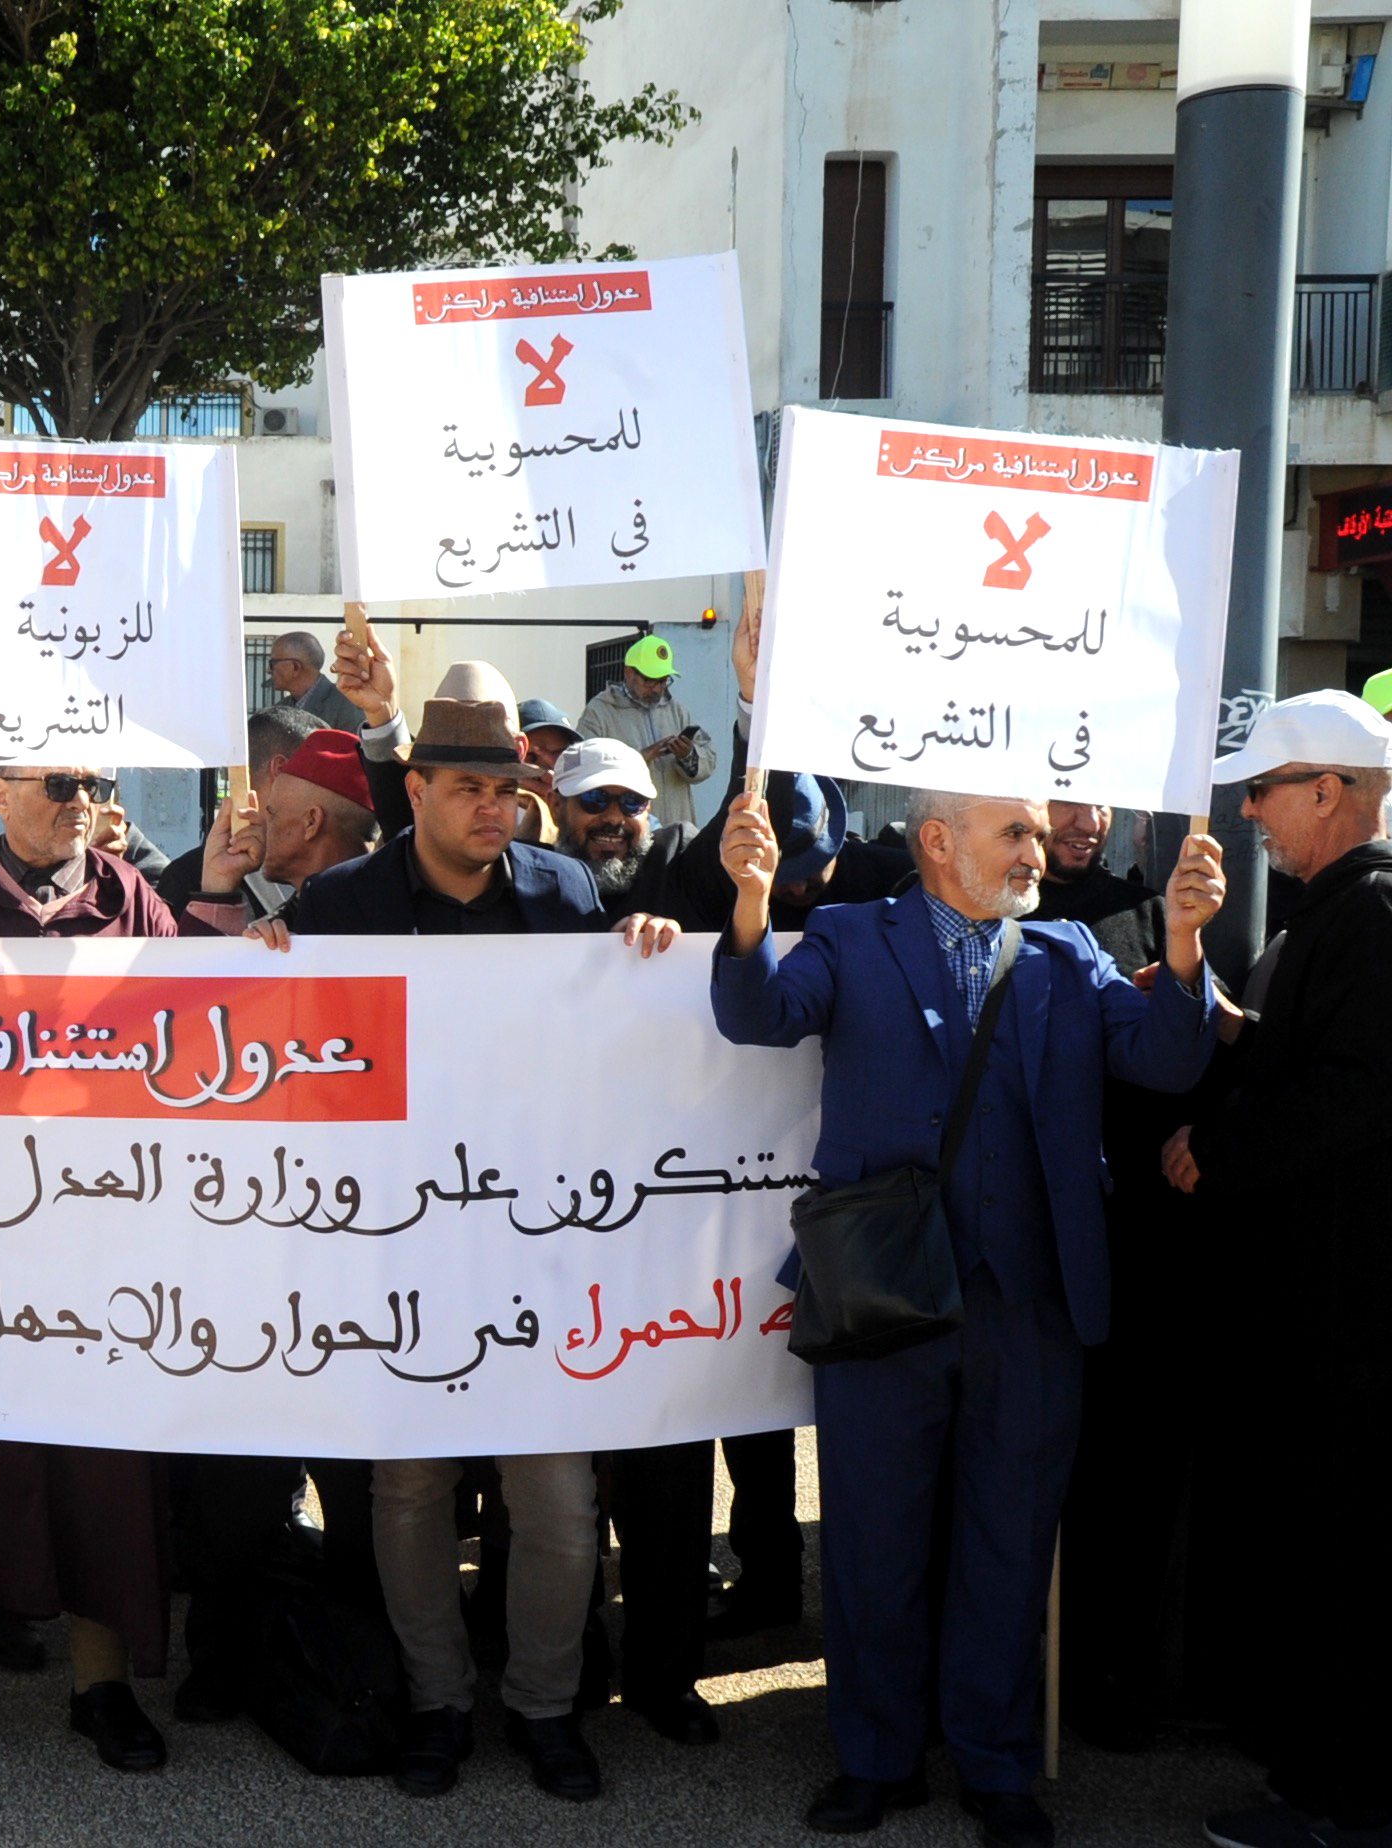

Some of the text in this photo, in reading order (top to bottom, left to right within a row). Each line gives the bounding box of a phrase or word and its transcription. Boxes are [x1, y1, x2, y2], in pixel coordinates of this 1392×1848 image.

[579, 282, 639, 311] عدول
[515, 332, 574, 407] لا
[102, 462, 155, 493] عدول
[444, 408, 640, 477] للمحسوبية
[1066, 459, 1138, 492] عدول
[38, 513, 92, 587] لا
[437, 499, 649, 587] في التشريع
[984, 511, 1051, 590] لا
[18, 601, 152, 660] للزبونية
[883, 590, 1106, 660] للمحسوبية
[852, 701, 1090, 787] في التشريع
[148, 1006, 365, 1107] عدول
[187, 1146, 361, 1234] وزارة
[320, 1142, 519, 1236] على
[510, 1147, 820, 1235] ستنكرون
[210, 1290, 420, 1377] الحوار
[378, 1290, 539, 1393] في
[555, 1277, 743, 1380] الحمراء
